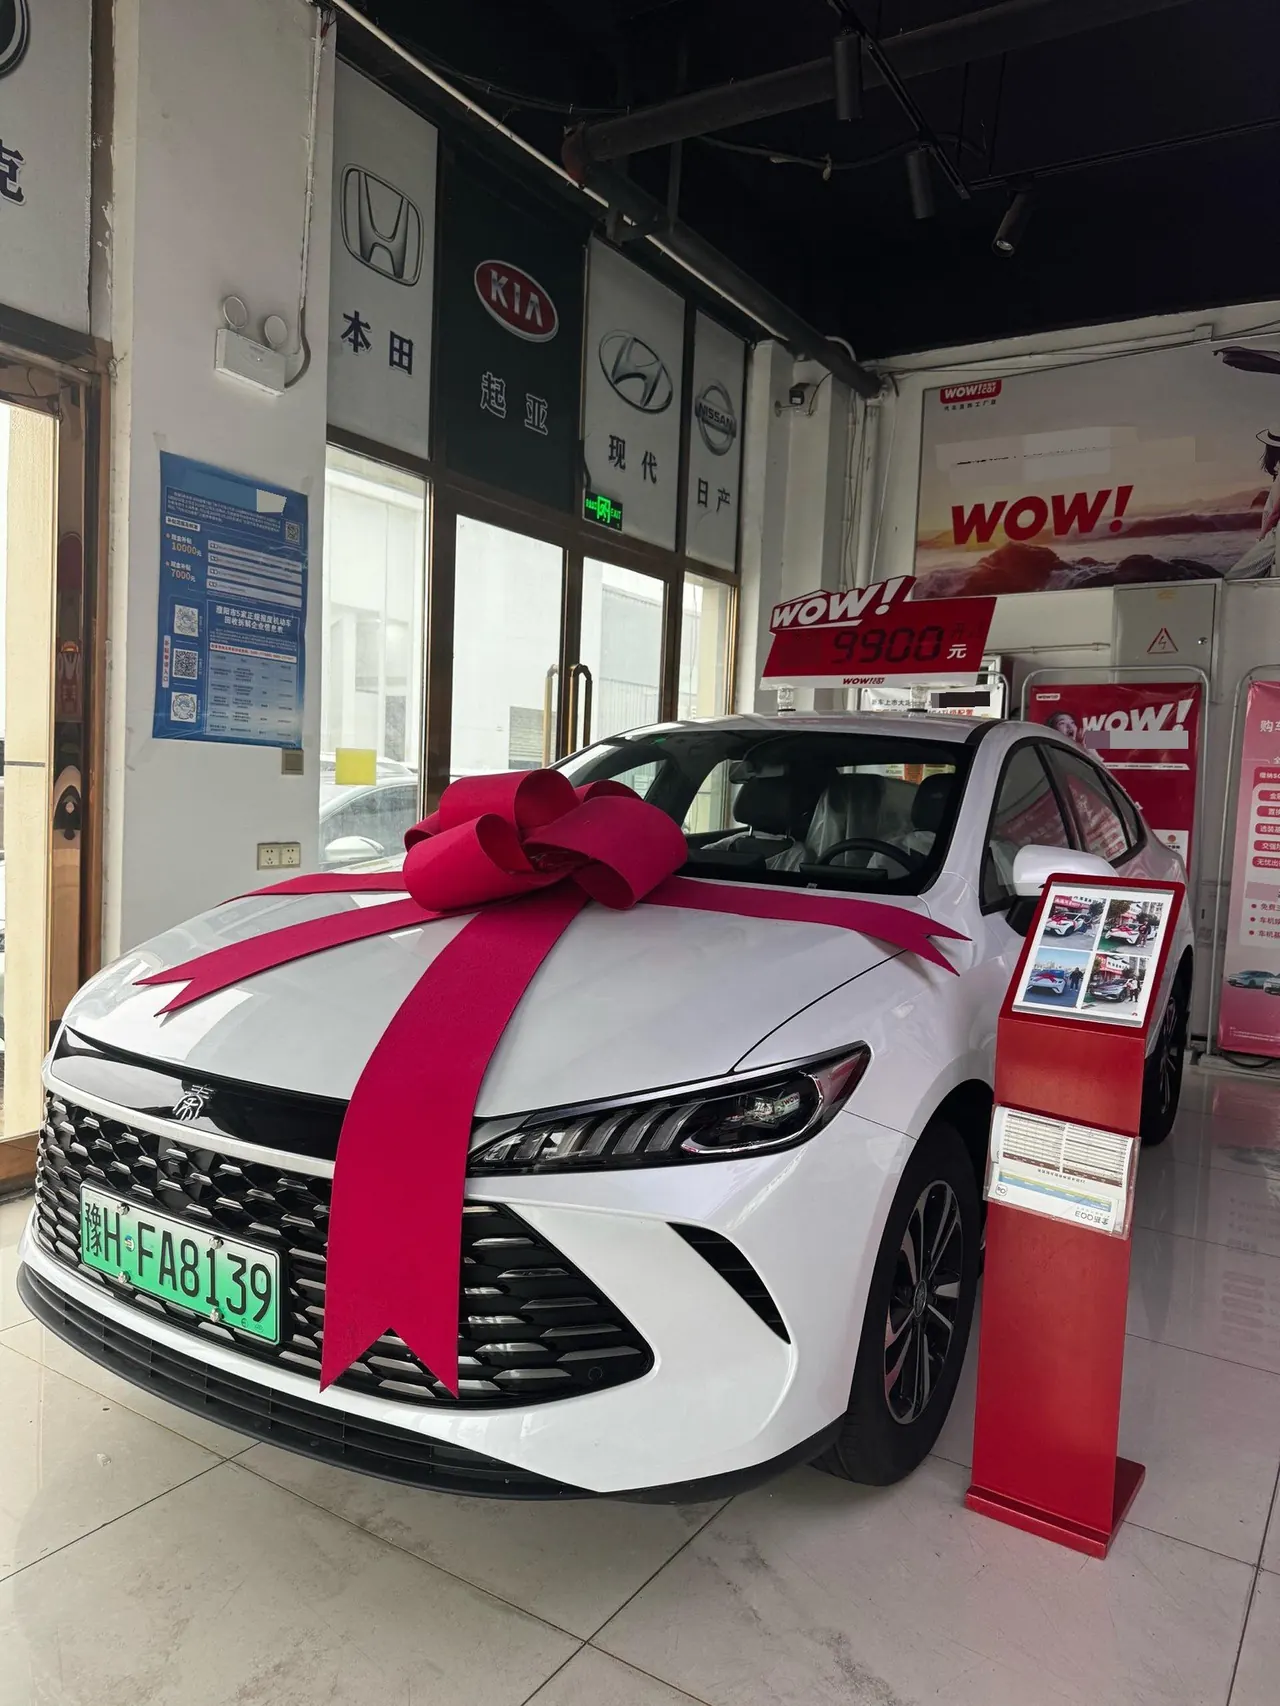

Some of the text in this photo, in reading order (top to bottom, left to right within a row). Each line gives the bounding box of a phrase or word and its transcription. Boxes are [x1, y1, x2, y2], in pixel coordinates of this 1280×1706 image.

[490, 269, 543, 328] KIA
[341, 310, 414, 375] 本田
[480, 371, 549, 435] 起亚
[699, 402, 734, 430] NISSAN
[608, 435, 658, 484] 现代
[697, 478, 731, 512] 日产
[952, 485, 1134, 545] WOW!
[773, 577, 904, 628] WOW!
[947, 643, 966, 659] 元
[1257, 858, 1280, 867] 无忧出
